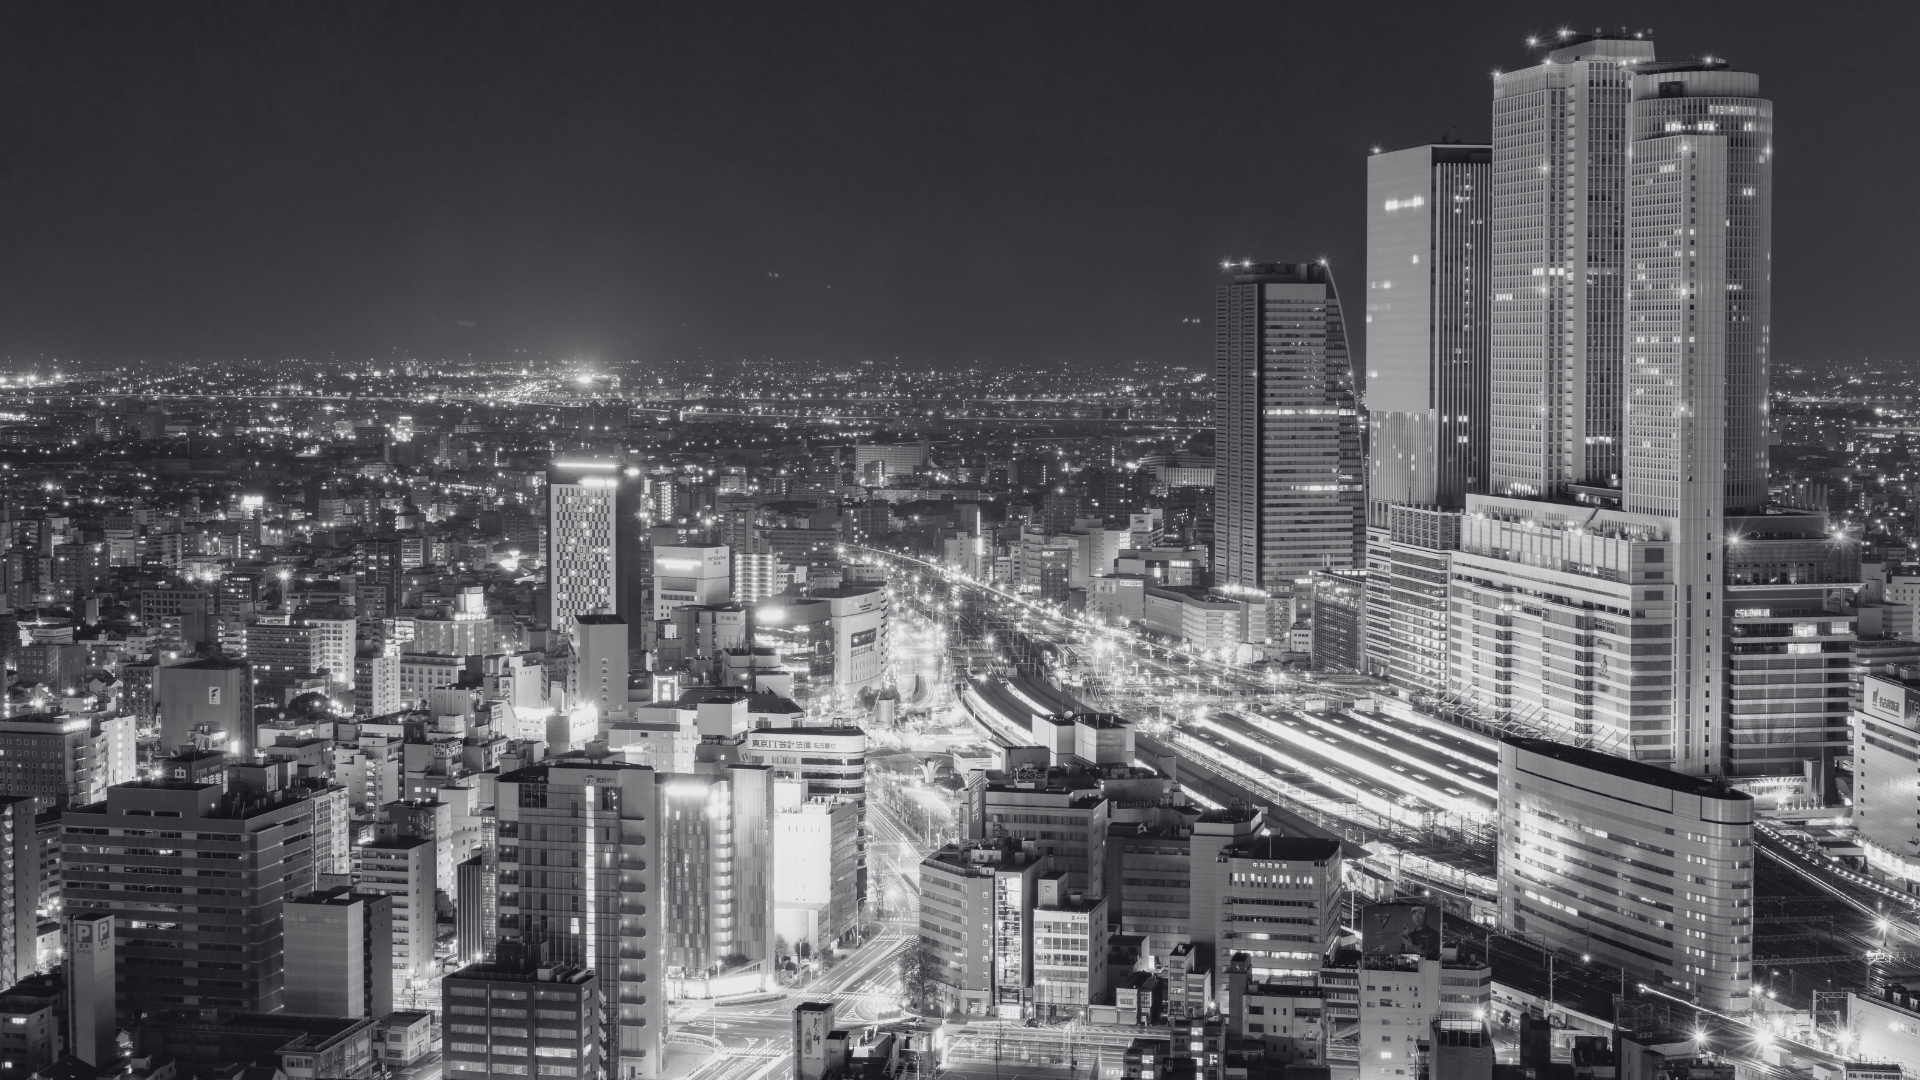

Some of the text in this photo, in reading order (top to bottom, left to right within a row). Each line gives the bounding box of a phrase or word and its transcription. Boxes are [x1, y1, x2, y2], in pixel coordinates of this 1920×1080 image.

[752, 739, 811, 749] 東京IT会計法律
[77, 925, 91, 942] P
[99, 923, 108, 940] P
